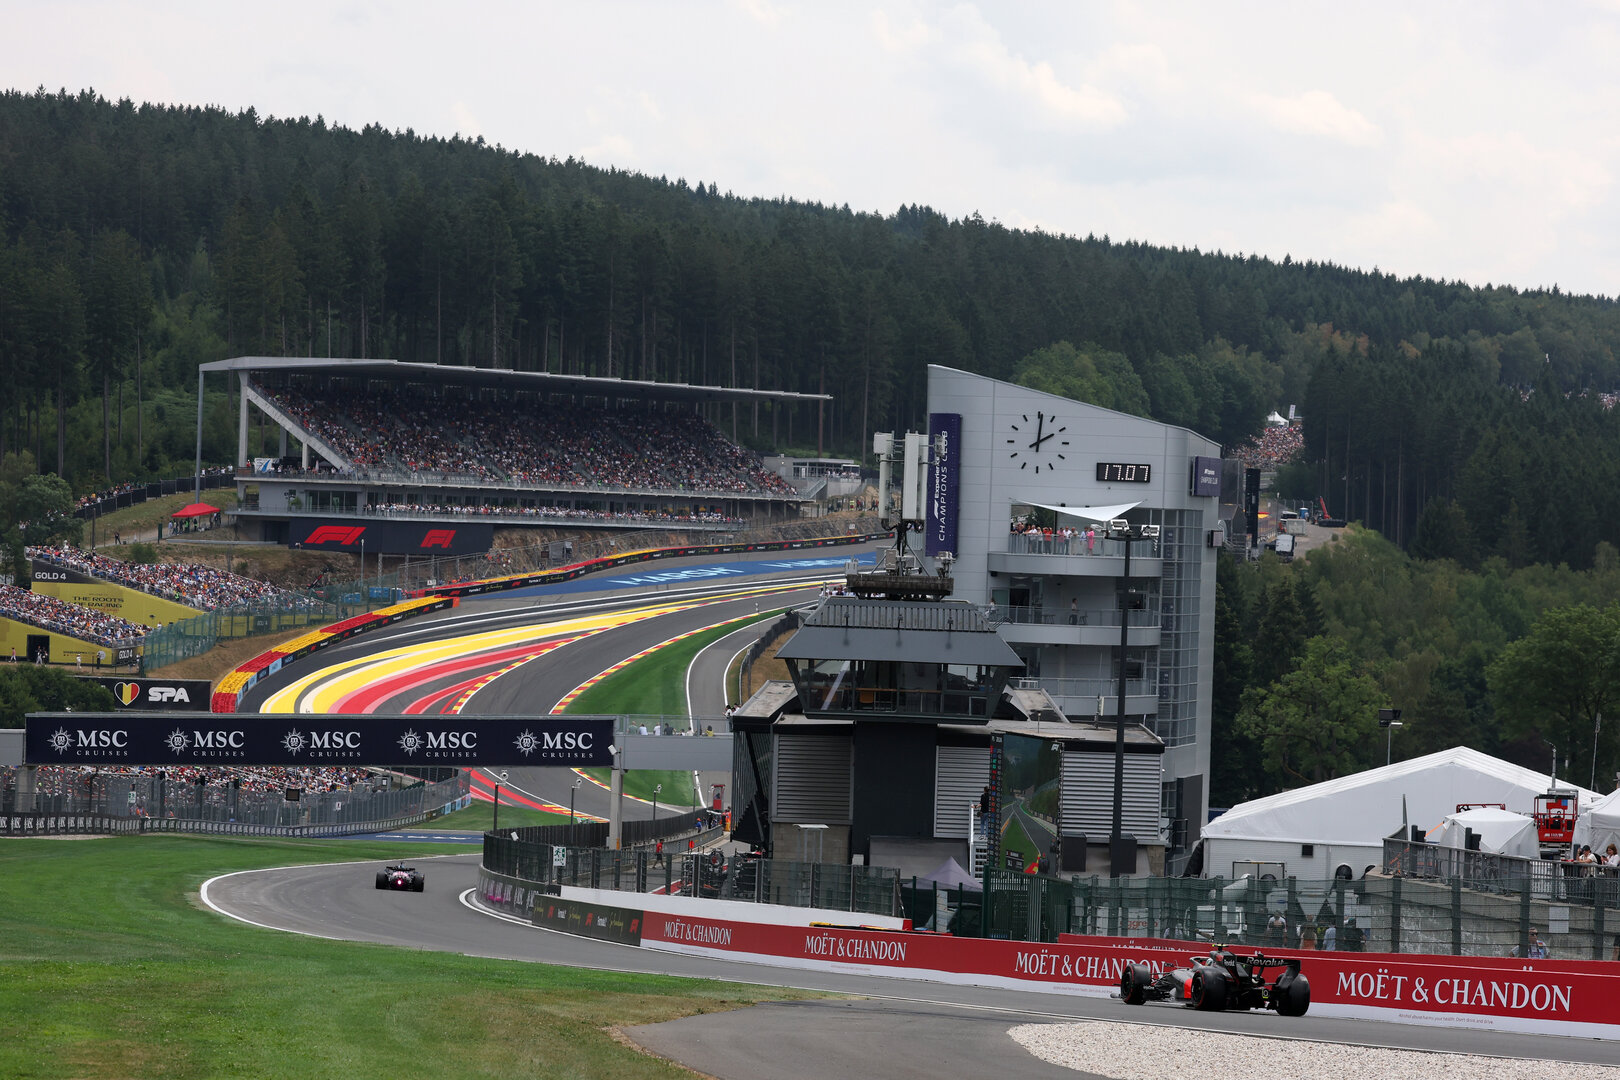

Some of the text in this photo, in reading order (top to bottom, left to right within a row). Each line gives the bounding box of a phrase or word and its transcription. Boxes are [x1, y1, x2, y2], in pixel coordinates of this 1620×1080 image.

[939, 466, 948, 541] CHAMPIONS
[119, 650, 132, 659] GOLD 4
[148, 687, 190, 702] SPA
[77, 730, 128, 747] MSC
[194, 731, 244, 748] MSC
[310, 732, 361, 749] MSC
[426, 732, 477, 749] MSC
[542, 733, 594, 750] MSC
[664, 918, 732, 945] MOËT & CHANDON
[804, 932, 906, 961] MOËT & CHANDON
[1015, 949, 1166, 981] MOËT & CHANN
[1247, 957, 1285, 967] Revolut
[1336, 968, 1573, 1012] MOËT & CHANDON
